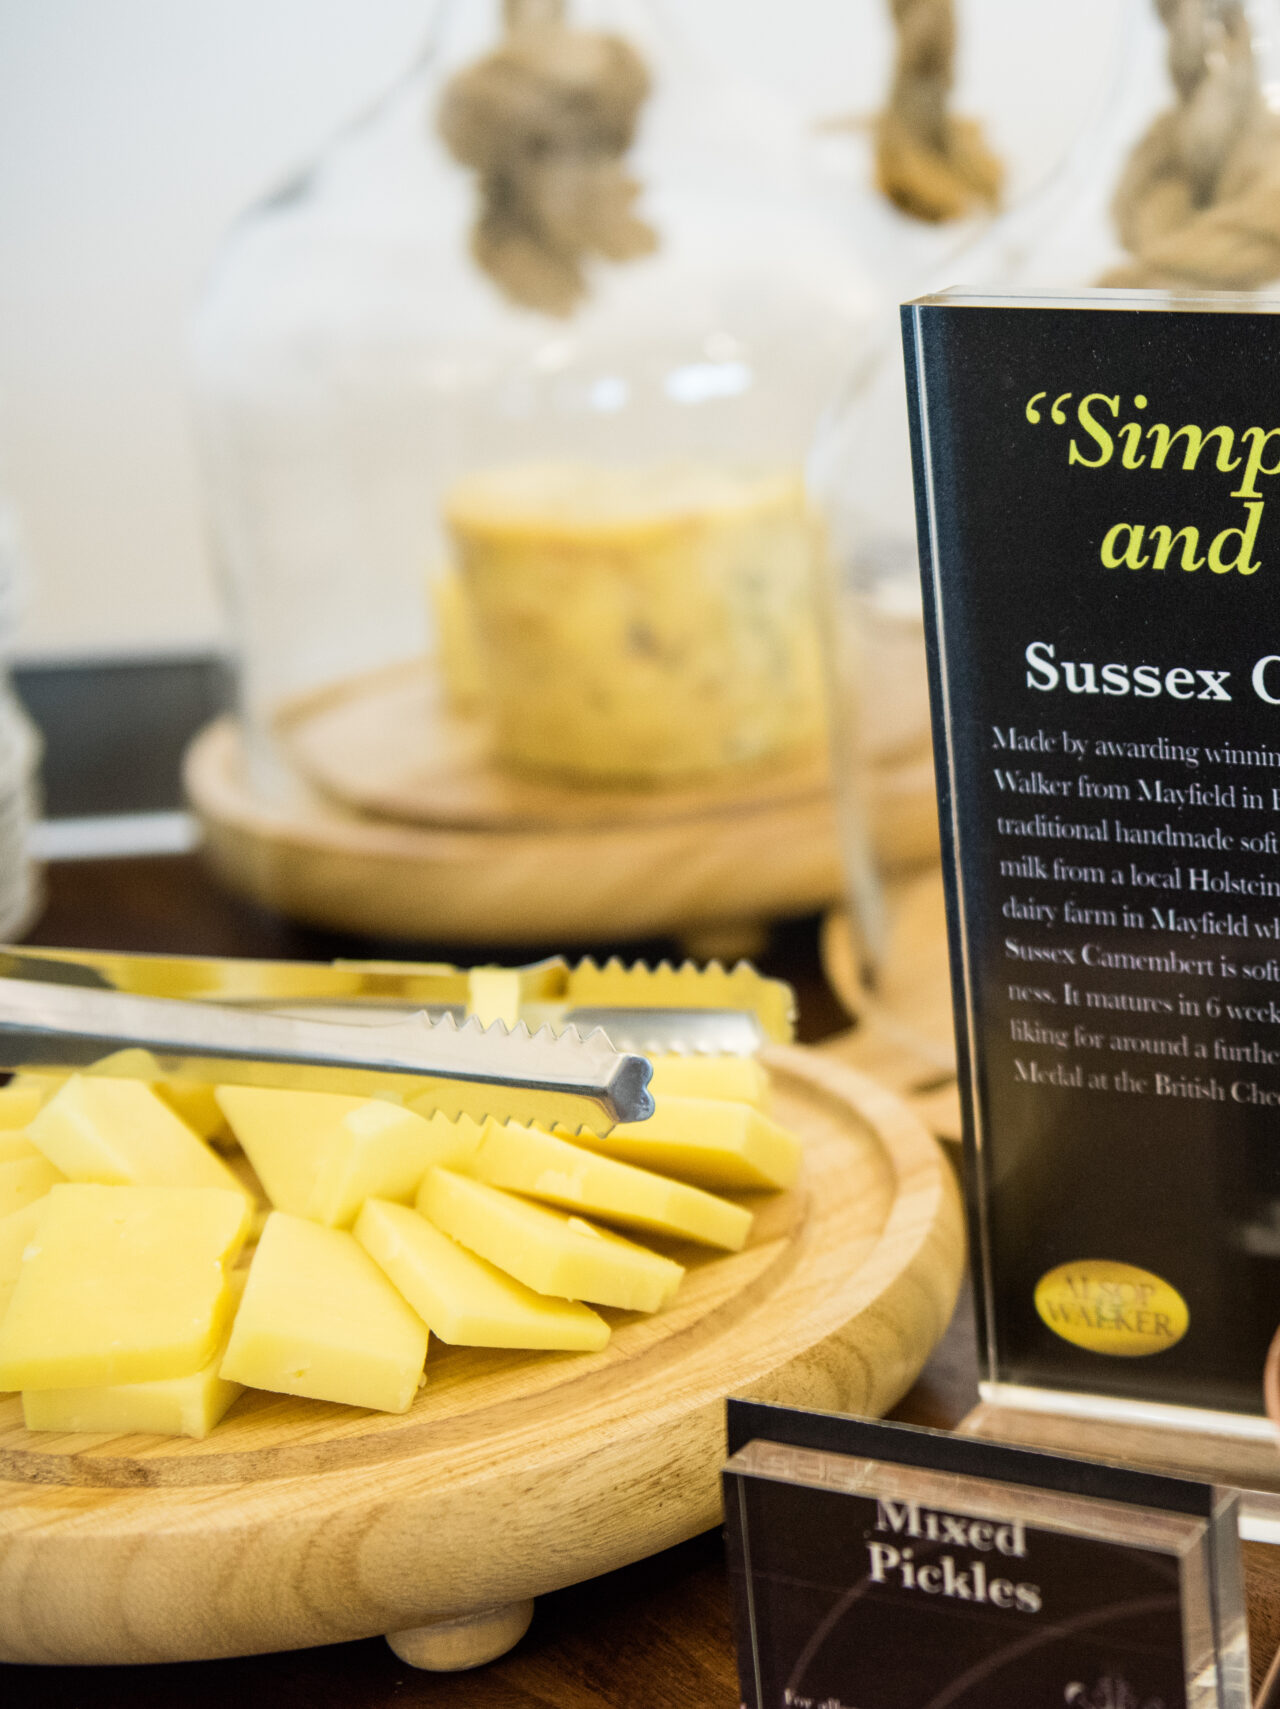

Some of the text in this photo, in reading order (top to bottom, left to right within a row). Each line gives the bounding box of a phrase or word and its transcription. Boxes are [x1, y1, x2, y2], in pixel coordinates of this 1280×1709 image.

[1100, 502, 1264, 577] and
[1025, 642, 1232, 701] Sussex
[992, 726, 1056, 752] Made
[1063, 731, 1088, 760] by
[1096, 736, 1199, 767] awarding
[994, 769, 1071, 795] Walker
[1078, 775, 1130, 800] from
[1137, 779, 1235, 810] Mayfield
[1242, 786, 1264, 810] in
[997, 814, 1108, 842] traditional
[1115, 820, 1234, 851] handmade
[1240, 832, 1279, 854] soft
[1000, 855, 1047, 879] milk
[1053, 858, 1104, 884] from
[1112, 868, 1124, 885] a
[1131, 864, 1181, 889] local
[1189, 867, 1280, 897] Holstein
[1002, 896, 1056, 927] dairy
[1064, 902, 1117, 926] farm
[1123, 905, 1144, 928] in
[1151, 907, 1248, 939] Mayfield
[1005, 938, 1076, 965] Sussex
[1081, 943, 1214, 976] Camembert
[1220, 955, 1236, 978] is
[1242, 956, 1280, 982] soft
[1008, 986, 1056, 1004] ness.
[1065, 983, 1084, 1006] It
[1086, 991, 1173, 1014] matures
[1179, 993, 1199, 1017] in
[1206, 997, 1221, 1018] 6
[1010, 1018, 1069, 1050] liking
[1074, 1024, 1103, 1049] for
[1110, 1031, 1189, 1058] around
[1195, 1042, 1208, 1059] a
[1014, 1059, 1083, 1088] Medal
[1088, 1070, 1109, 1090] at
[1114, 1071, 1148, 1093] the
[1155, 1073, 1225, 1101] British
[1046, 1300, 1174, 1337] WALKER
[875, 1498, 1027, 1557] Mixed
[867, 1541, 1042, 1614] Pickles
